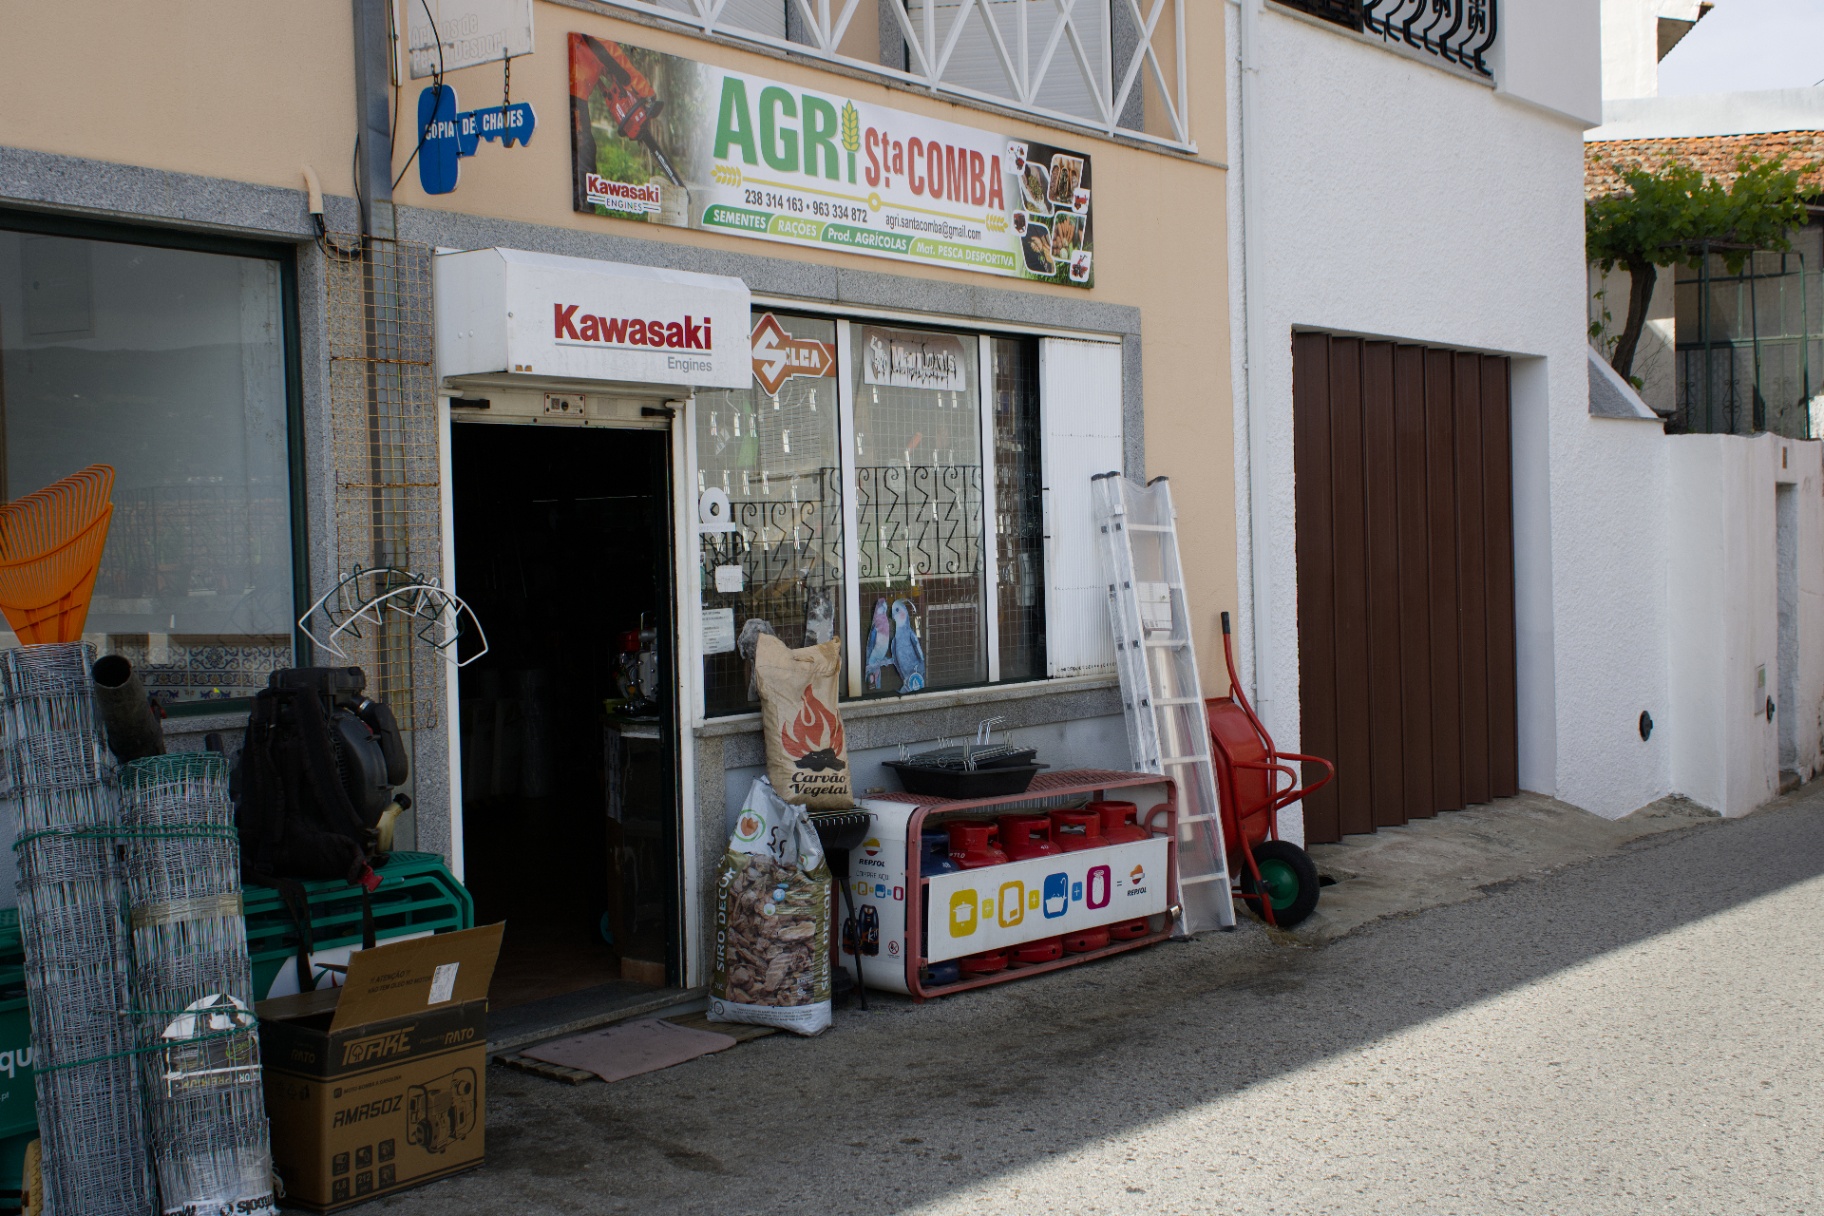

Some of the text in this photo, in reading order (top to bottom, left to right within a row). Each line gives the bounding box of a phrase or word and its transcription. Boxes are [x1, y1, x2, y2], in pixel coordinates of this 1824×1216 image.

[424, 109, 524, 141] CÓPIA DE CHAVES
[588, 175, 659, 203] Kawasaki
[606, 198, 643, 211] ENGINES
[745, 189, 868, 223] 238 314 163 963 334 872
[713, 209, 767, 230] SEMENTES
[777, 219, 817, 238] RAÇÕES
[885, 213, 982, 241] agri.santacomba@gmail.com
[827, 227, 907, 251] Prod. AGRÍCOLAS
[916, 242, 1014, 267] Mat. PESCA DESPORTIVA
[554, 302, 712, 350] Kawasaki
[667, 356, 713, 374] Engines
[791, 771, 846, 784] Carvão
[788, 783, 849, 798] Vegetal
[858, 858, 885, 868] REPSOL
[717, 866, 737, 924] DECOR
[1126, 886, 1147, 897] REPSOL
[716, 931, 726, 973] SIRO
[444, 1027, 475, 1045] RATO
[357, 1173, 371, 1184] 212
